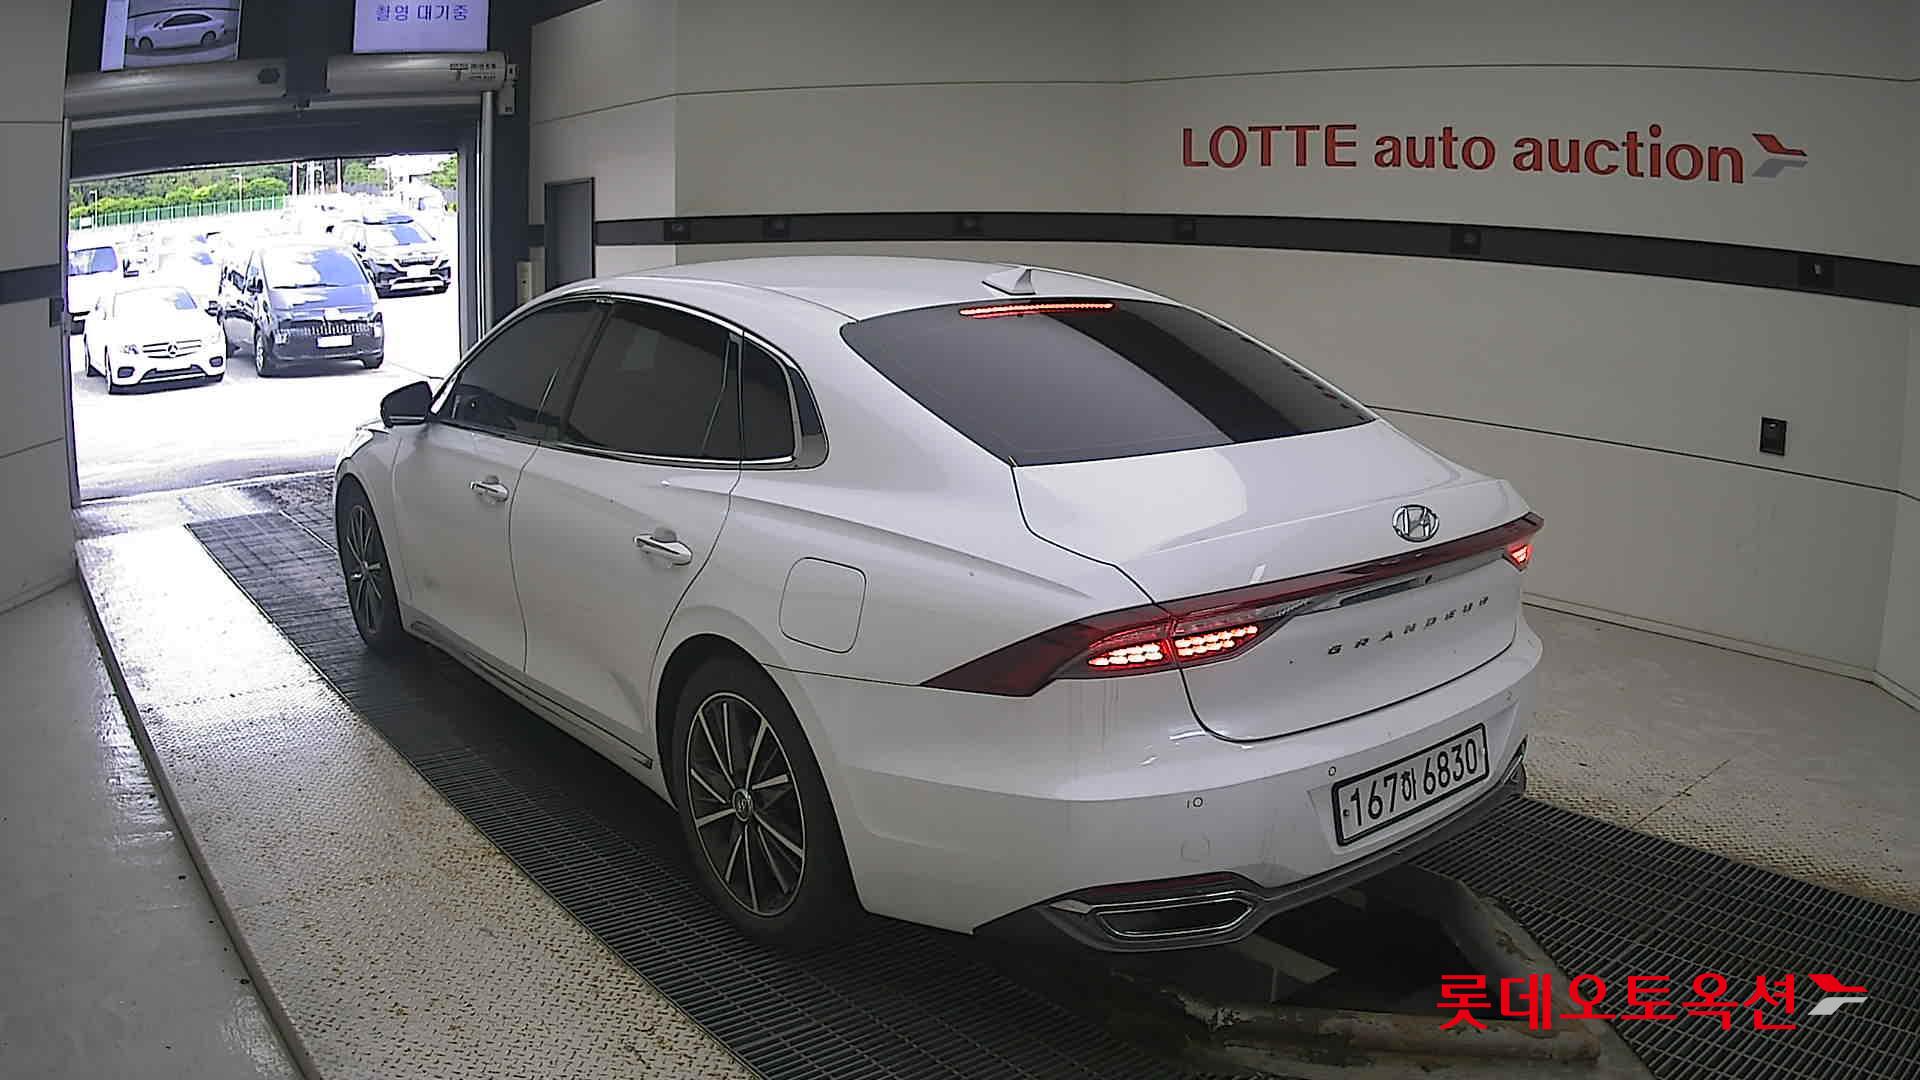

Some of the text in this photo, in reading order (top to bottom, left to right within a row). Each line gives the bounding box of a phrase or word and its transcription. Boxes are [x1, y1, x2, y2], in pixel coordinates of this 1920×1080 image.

[376, 4, 468, 21] 촬영 대기중
[1182, 123, 1744, 184] LOTTE auto auction
[1327, 596, 1489, 655] GRANDEUR
